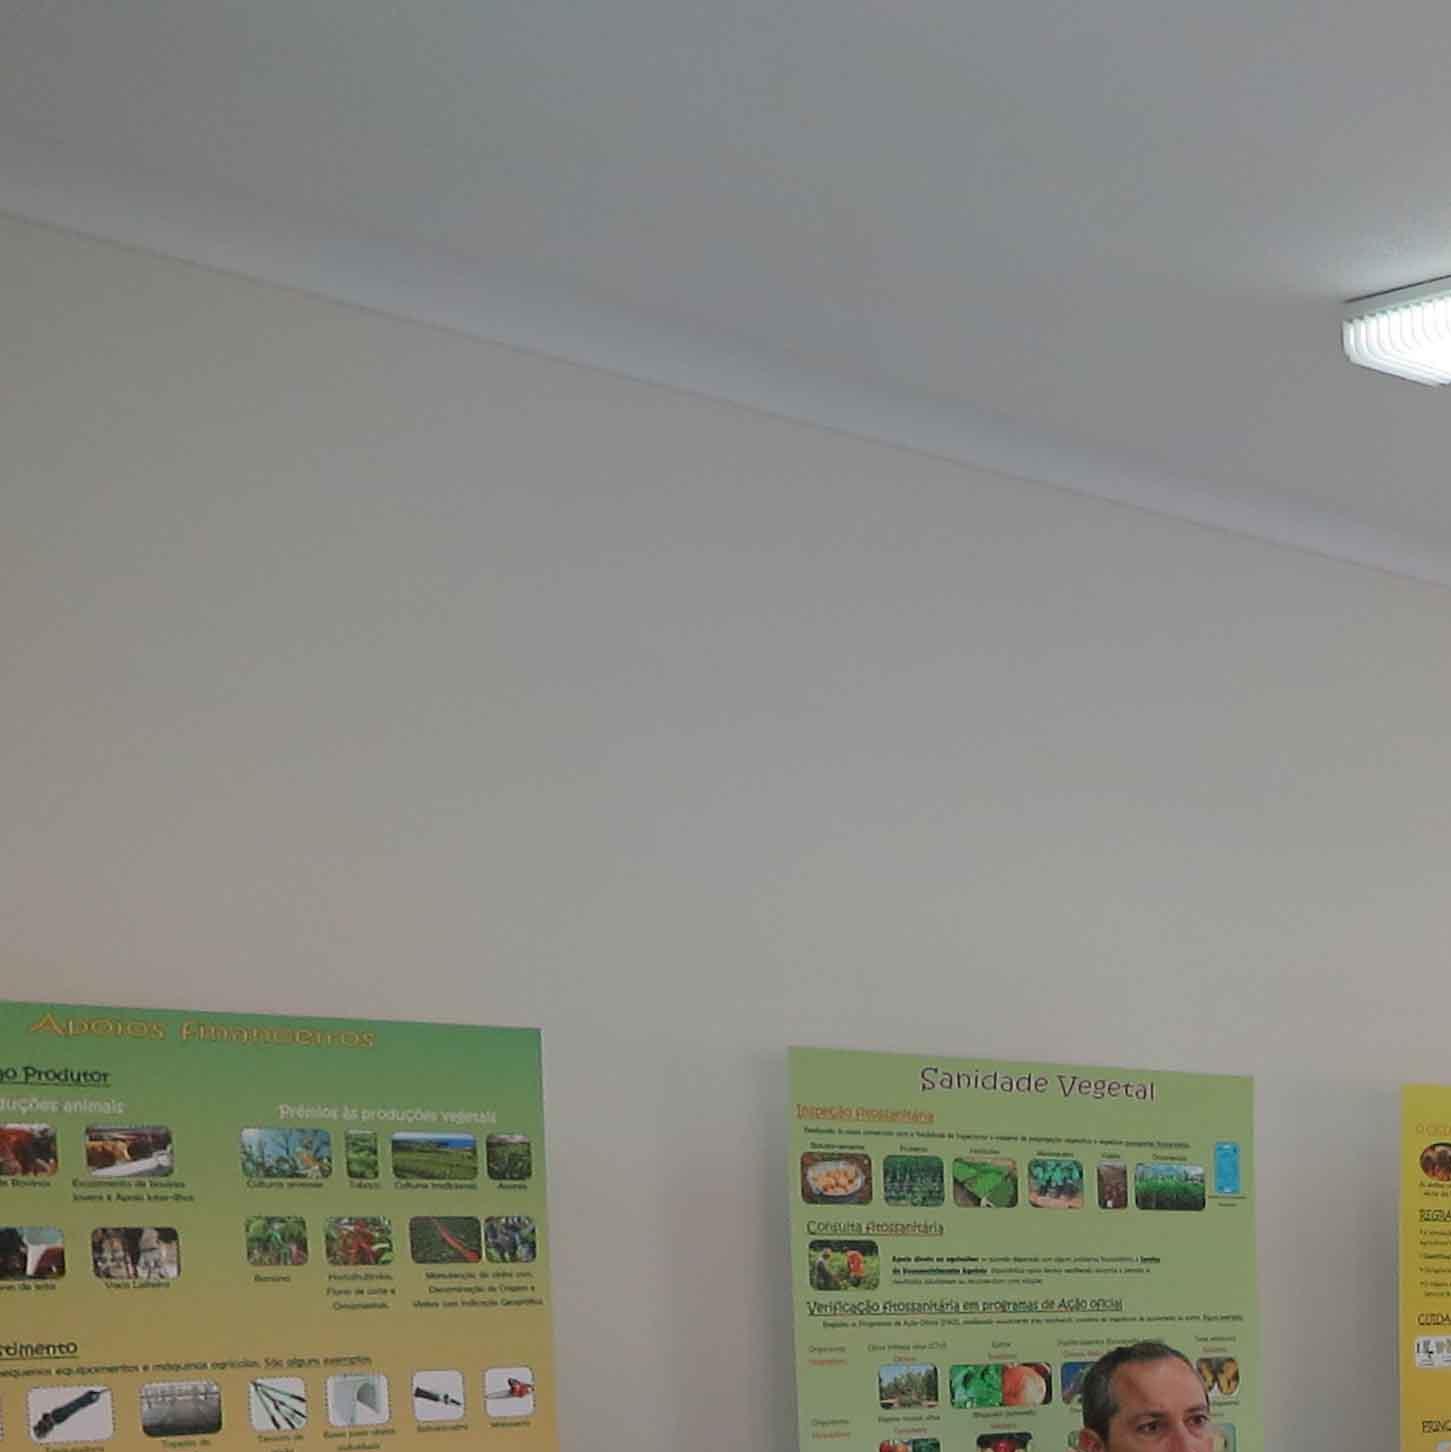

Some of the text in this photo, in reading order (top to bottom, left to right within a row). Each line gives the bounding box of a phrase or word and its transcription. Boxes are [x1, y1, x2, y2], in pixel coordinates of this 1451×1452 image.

[31, 1012, 165, 1040] Apoios
[24, 1065, 111, 1084] Produtor
[920, 1066, 1156, 1101] Sanidade Vegetal
[64, 1099, 125, 1114] animais
[361, 1108, 436, 1124] produções
[440, 1110, 496, 1124] vegetais
[807, 1220, 944, 1237] Consulta fitossanitária
[807, 1298, 1121, 1316] Verificação fitossanitária em programas de Ação oficial
